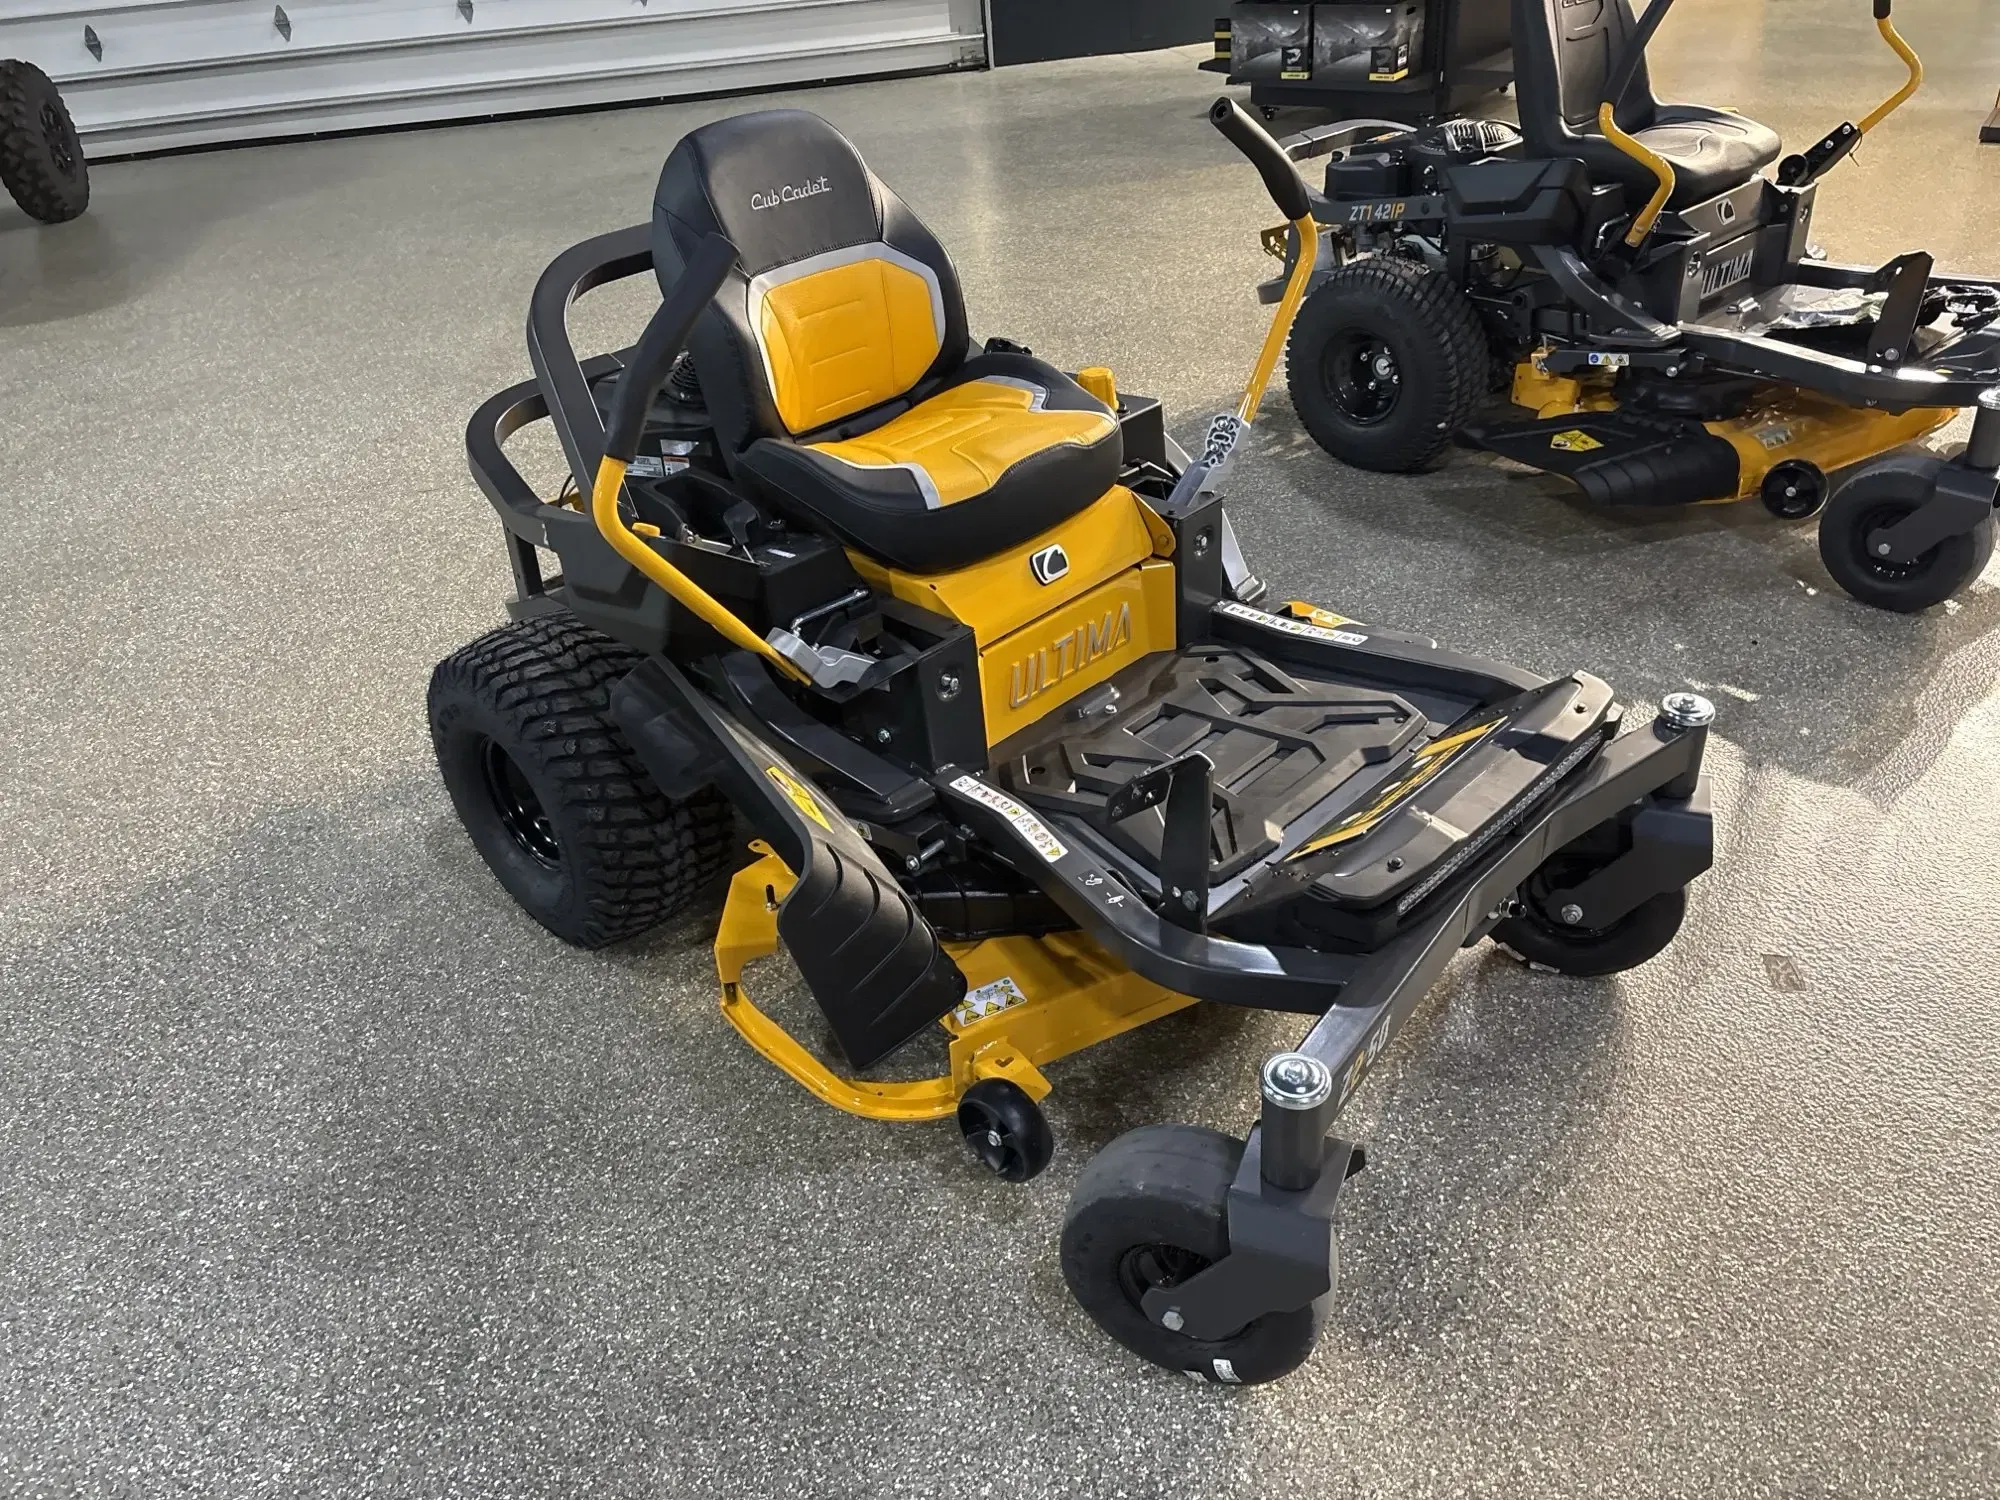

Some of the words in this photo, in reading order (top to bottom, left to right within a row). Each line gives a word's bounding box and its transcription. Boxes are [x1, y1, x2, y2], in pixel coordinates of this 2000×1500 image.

[751, 189, 780, 210] Cub
[782, 176, 830, 202] Cadet
[1349, 204, 1373, 221] ZT1
[1374, 202, 1405, 220] 42IP
[1700, 248, 1754, 299] ULTIMA
[1010, 601, 1130, 708] ULTIMA
[1366, 1014, 1391, 1067] 50
